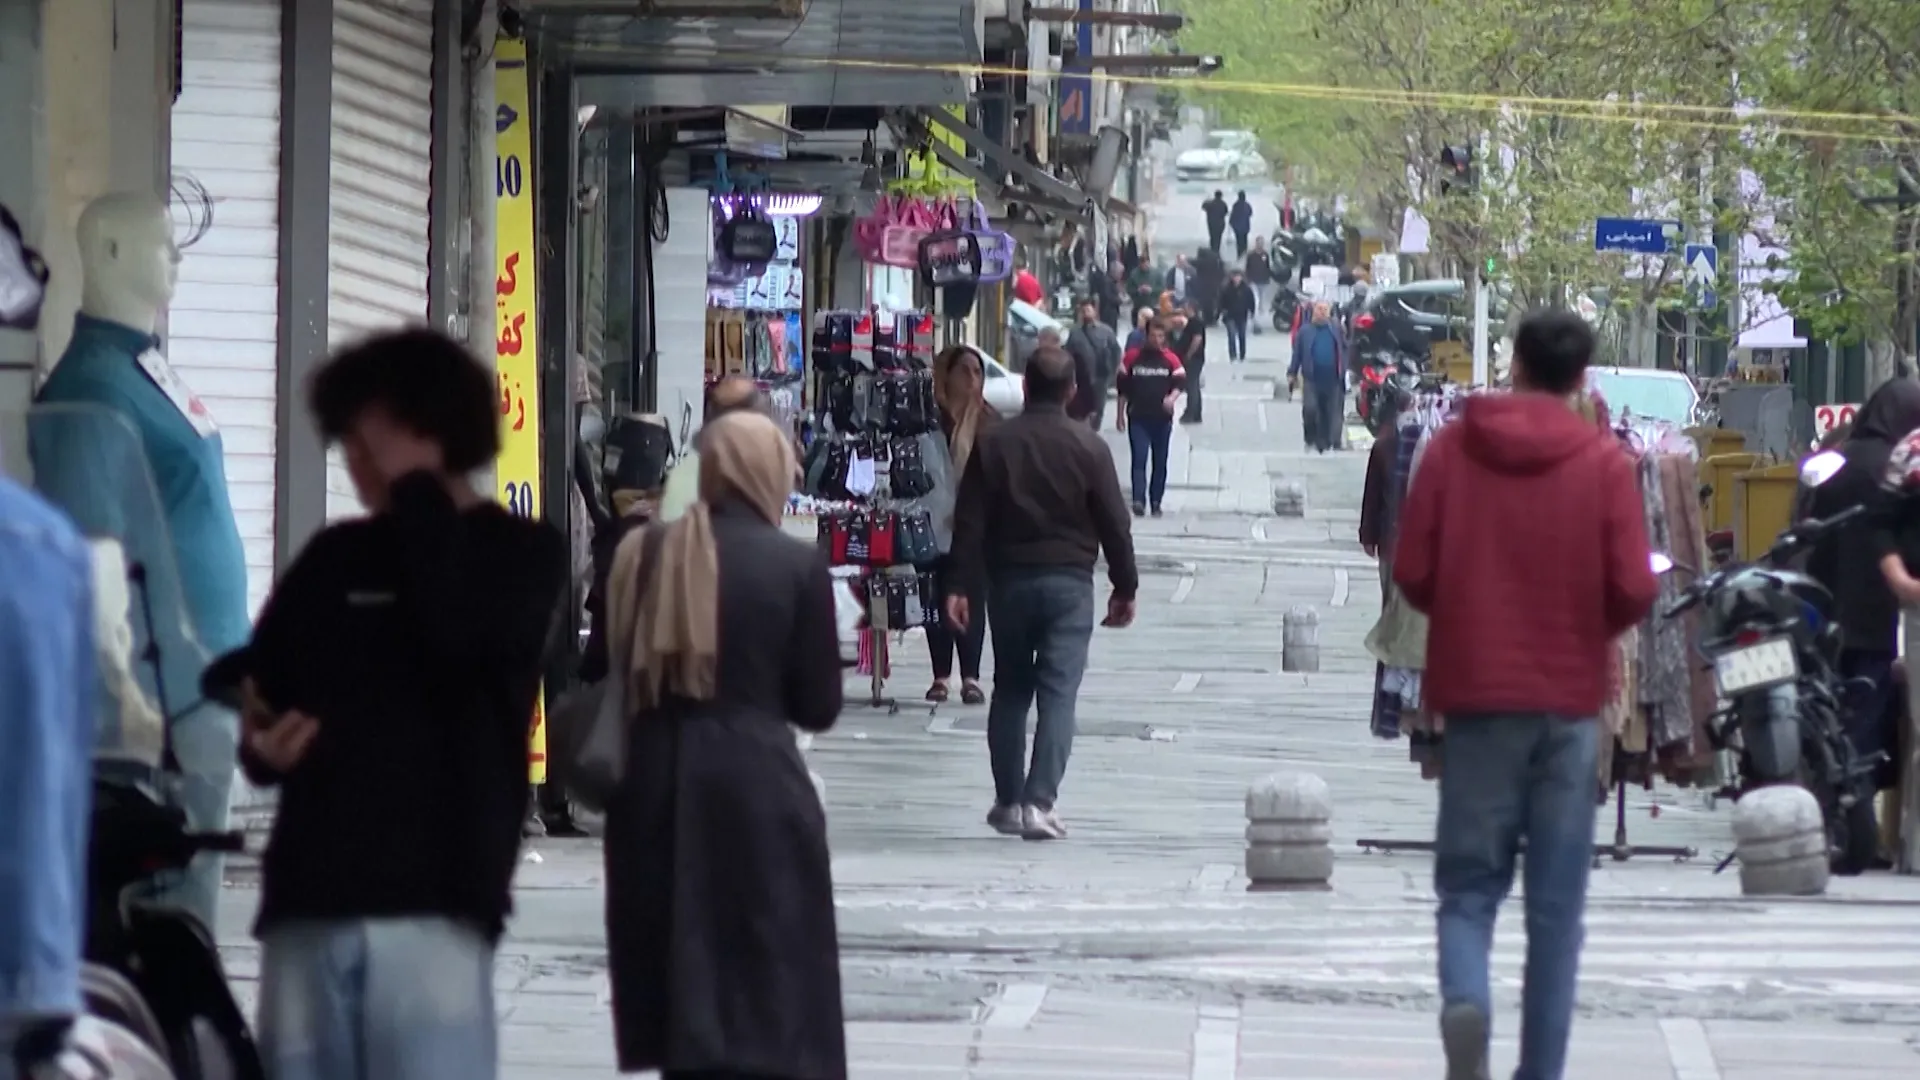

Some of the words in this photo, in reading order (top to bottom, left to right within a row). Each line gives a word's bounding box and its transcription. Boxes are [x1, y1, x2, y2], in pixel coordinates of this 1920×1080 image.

[496, 250, 520, 308] کی
[496, 311, 526, 356] کف
[504, 480, 534, 520] 30
